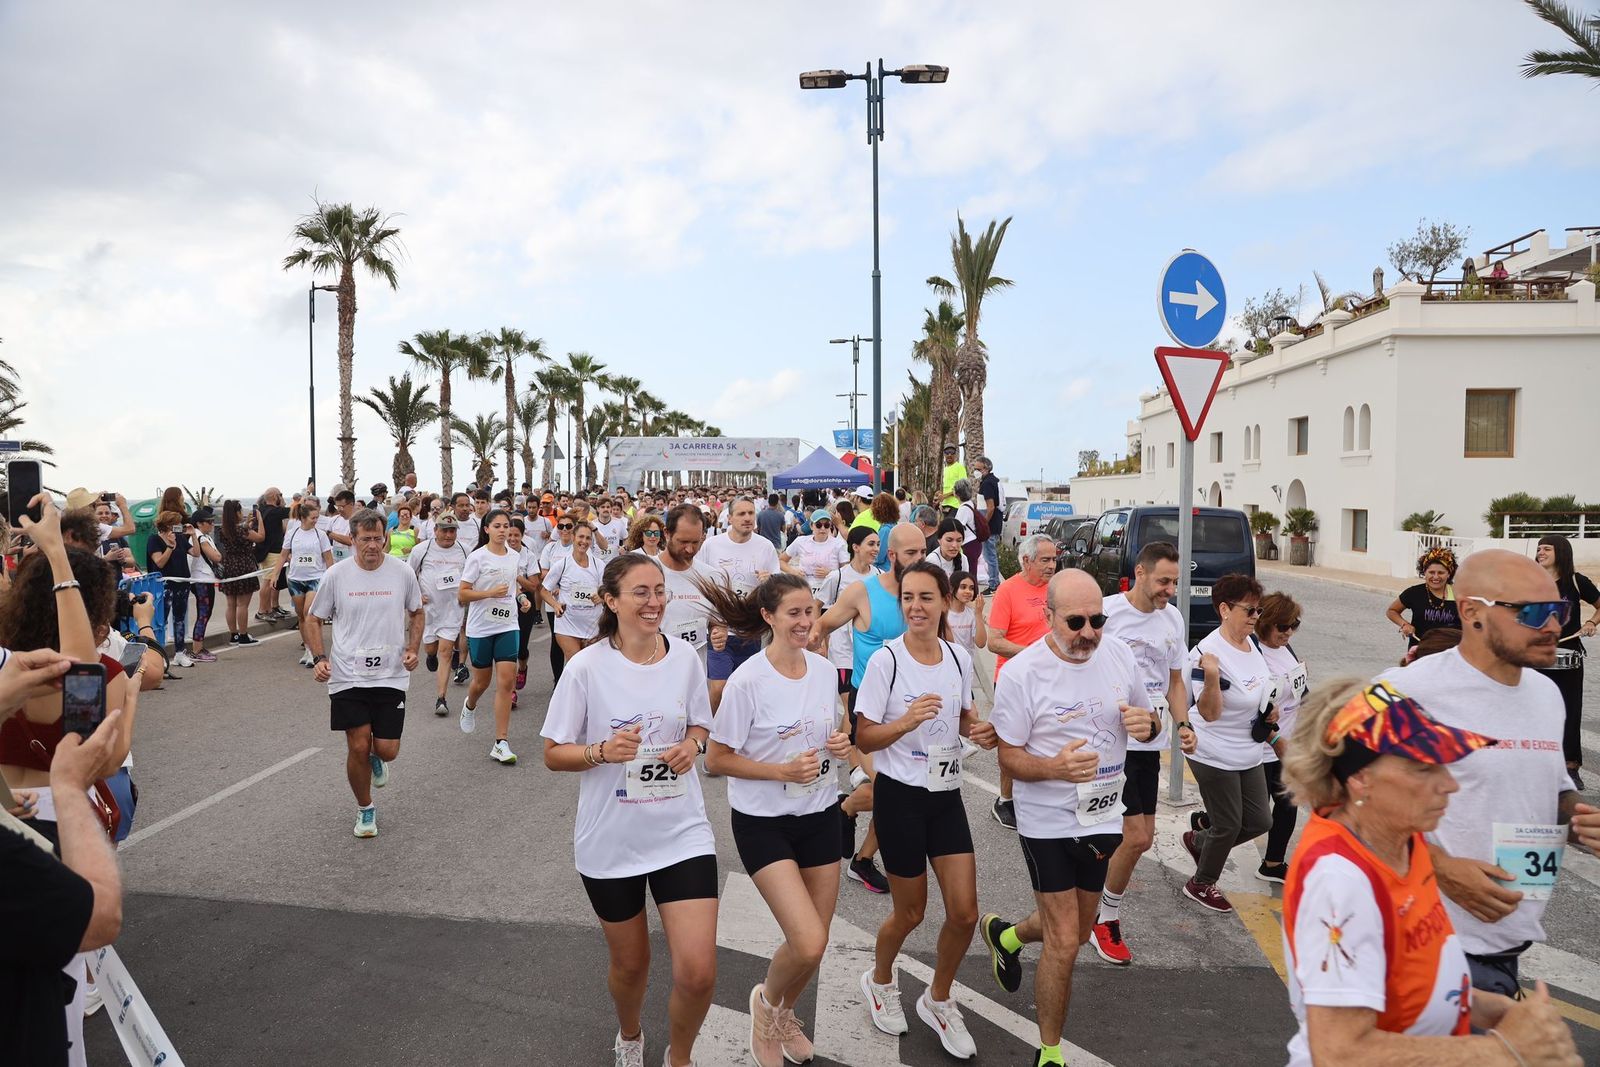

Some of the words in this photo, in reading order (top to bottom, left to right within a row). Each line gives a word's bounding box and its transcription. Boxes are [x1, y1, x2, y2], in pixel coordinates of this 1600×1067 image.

[682, 442, 724, 450] CARRERA
[726, 442, 737, 450] 5K
[574, 591, 591, 600] 394
[491, 607, 510, 618] 868
[681, 630, 697, 642] 55
[365, 656, 381, 667] 52
[640, 763, 678, 782] 529
[938, 758, 960, 778] 746
[1086, 791, 1118, 813] 269
[1525, 827, 1552, 836] CARRERA
[1524, 851, 1558, 877] 34
